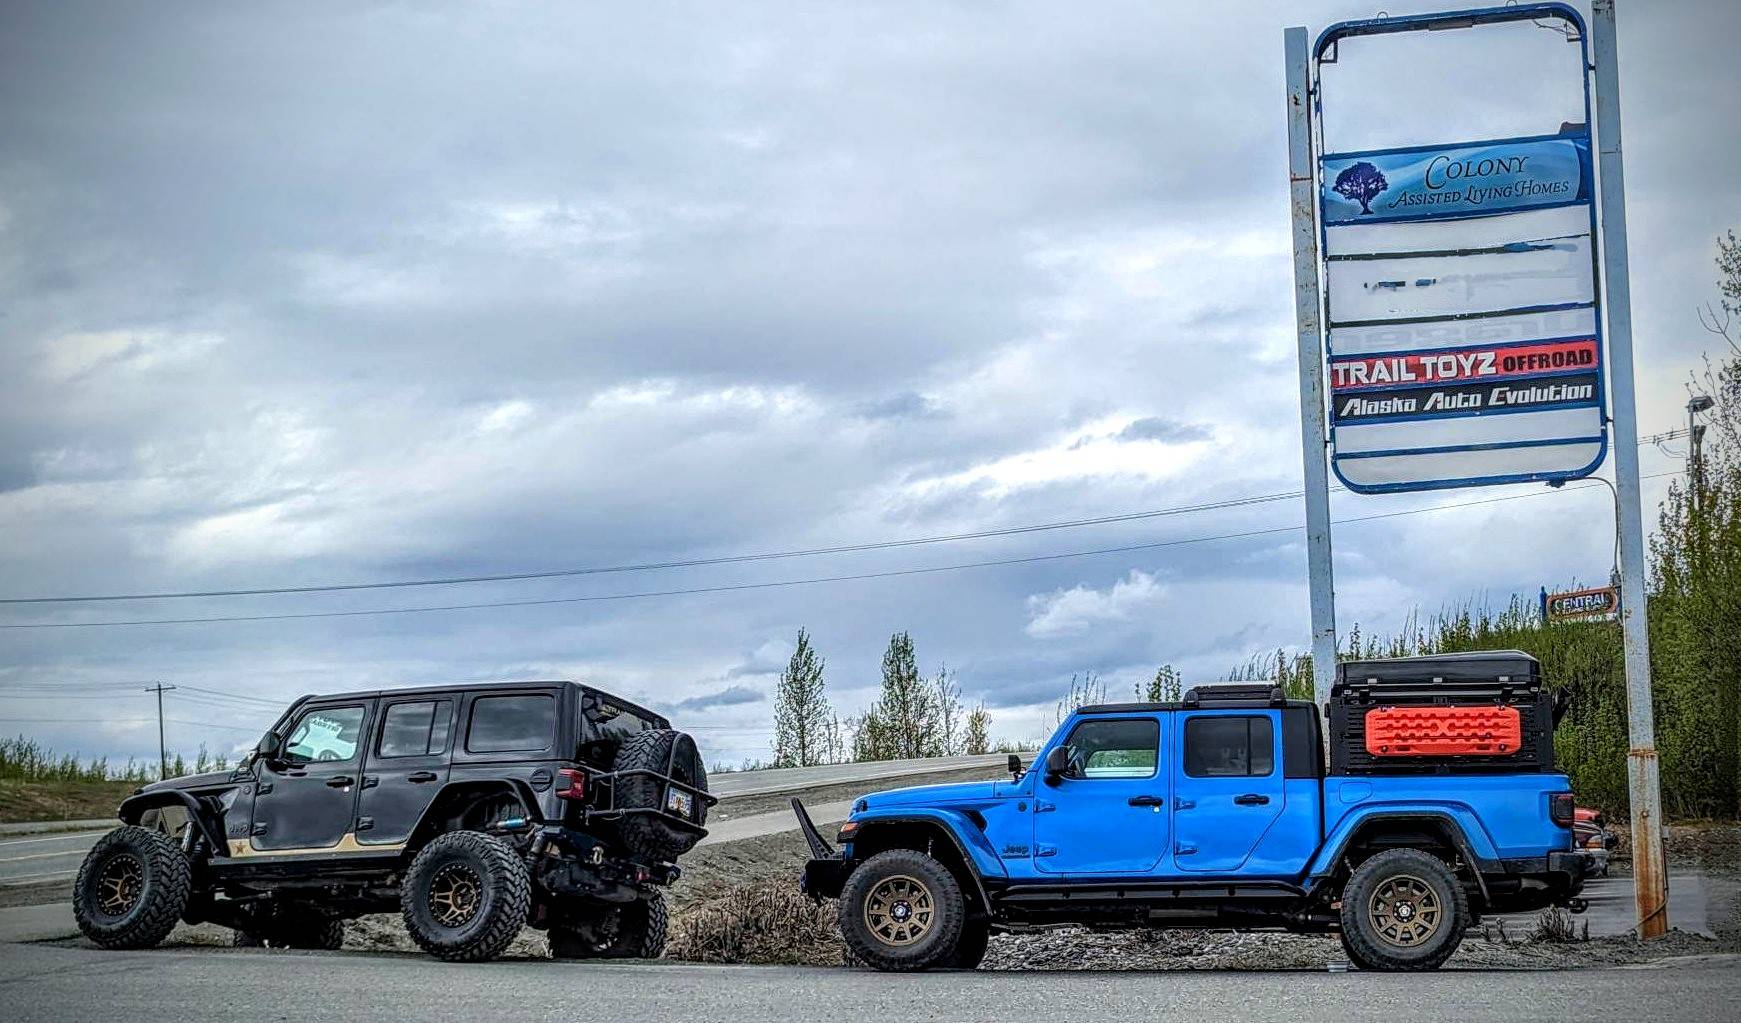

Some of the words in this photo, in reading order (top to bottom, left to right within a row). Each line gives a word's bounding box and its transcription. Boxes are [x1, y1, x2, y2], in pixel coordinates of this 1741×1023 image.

[1425, 155, 1530, 190] COLONY
[1388, 190, 1462, 208] ASSISTED
[1332, 358, 1416, 386] TRAIL
[1420, 352, 1497, 380] TOYZ
[1502, 349, 1593, 372] OFFROAD
[1340, 397, 1417, 417] Alaska
[1423, 391, 1482, 411] Auto
[1488, 384, 1593, 406] Evolution
